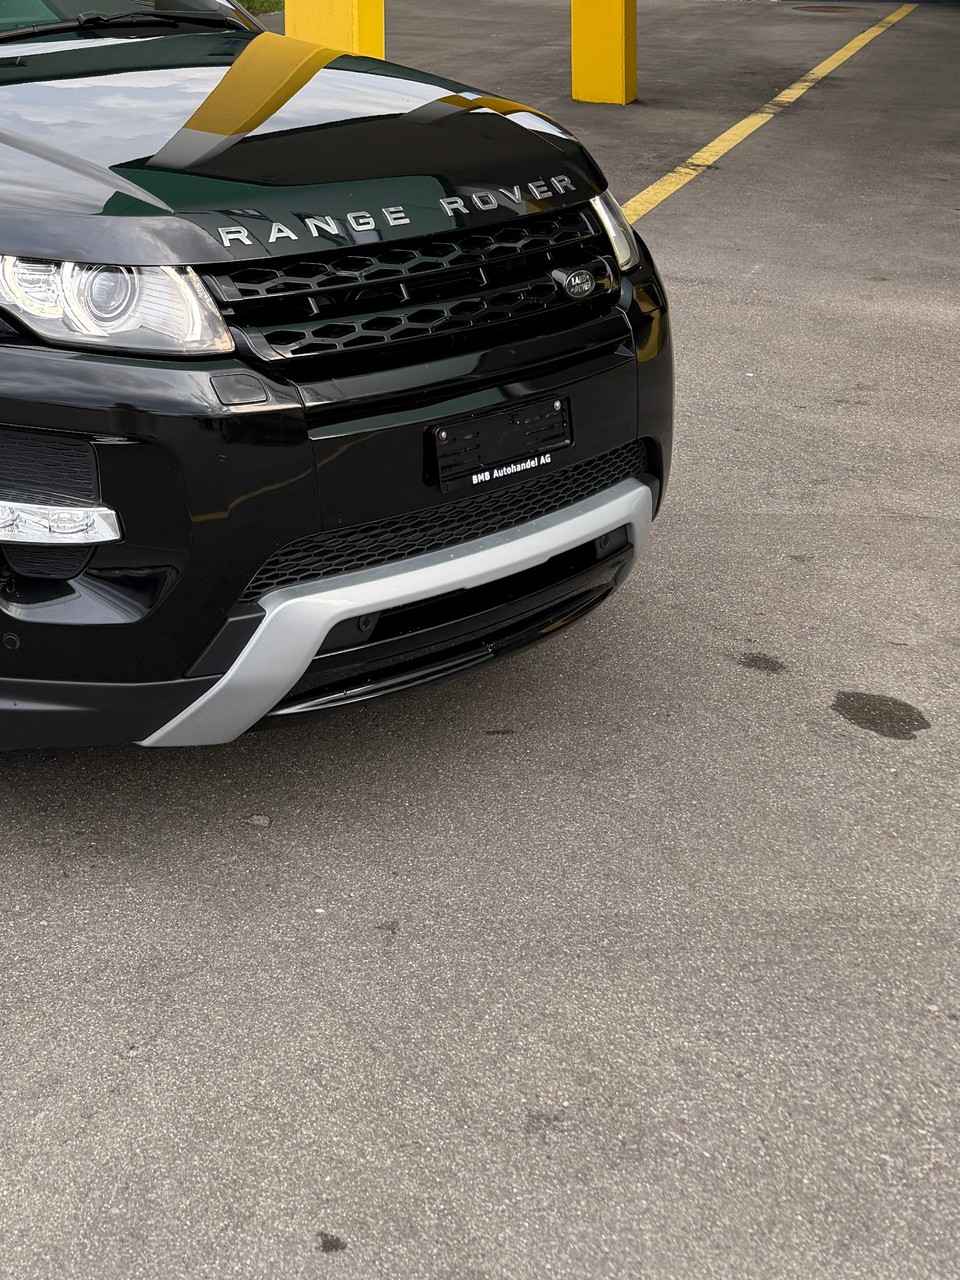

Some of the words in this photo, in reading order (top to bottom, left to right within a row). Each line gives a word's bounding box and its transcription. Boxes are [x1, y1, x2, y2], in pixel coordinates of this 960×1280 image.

[217, 206, 410, 247] RANGE
[440, 175, 576, 217] ROVER
[472, 471, 491, 484] BMB
[493, 457, 538, 479] Autohandel
[540, 453, 552, 465] AG
